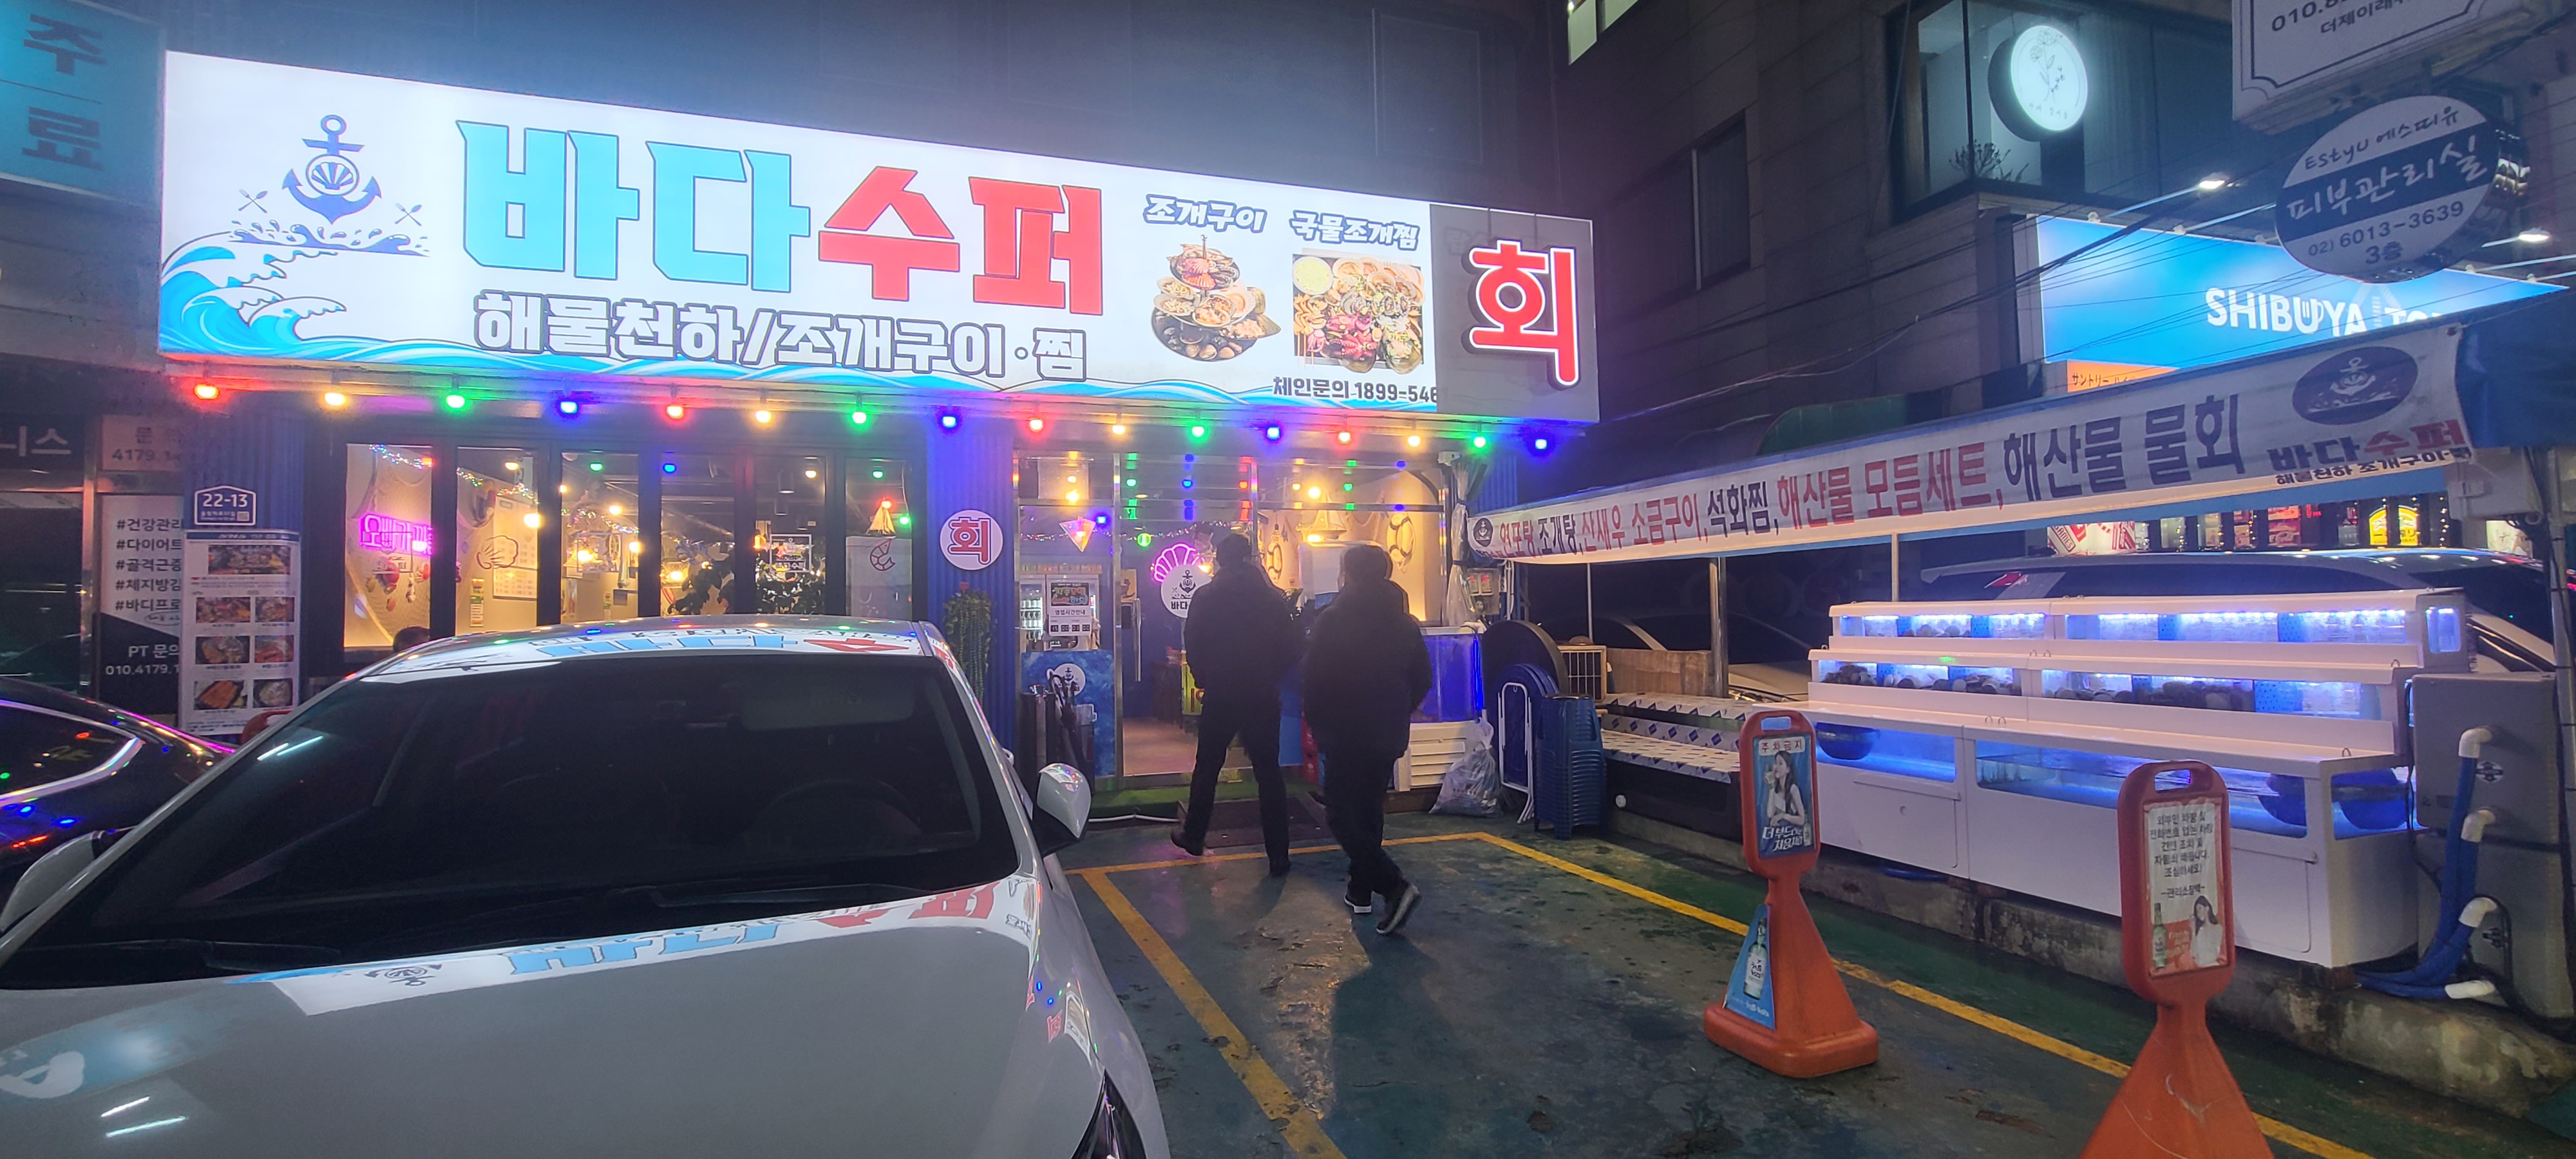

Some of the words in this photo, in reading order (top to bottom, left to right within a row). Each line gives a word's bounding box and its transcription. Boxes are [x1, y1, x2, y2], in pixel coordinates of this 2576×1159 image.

[2286, 135, 2487, 220] 피부관리실
[456, 120, 1103, 316] 바다수퍼
[1143, 194, 1267, 233] 조개구이
[1289, 210, 1420, 251] 국물조개찜
[2339, 200, 2464, 246] 6013-3639
[2365, 241, 2403, 265] 3층
[1469, 240, 1579, 386] 회
[2205, 287, 2368, 337] SHIBUYA
[1273, 376, 1349, 399] 체인문의
[2266, 419, 2467, 471] 바다수퍼
[1631, 493, 1708, 545] 소금구이,
[1777, 466, 1855, 530] 해산물
[1864, 442, 2003, 517] 모듬세트,
[2003, 416, 2127, 502] 해산물
[2144, 394, 2246, 486] 물회
[202, 493, 249, 508] 22-13
[116, 538, 182, 552] #다이어트
[947, 516, 992, 565] 회
[115, 599, 181, 612] #바디프로
[1171, 601, 1188, 610] 바다
[128, 645, 149, 657] PT
[1761, 739, 1803, 753] 주차금지
[2157, 814, 2179, 825] 외부인
